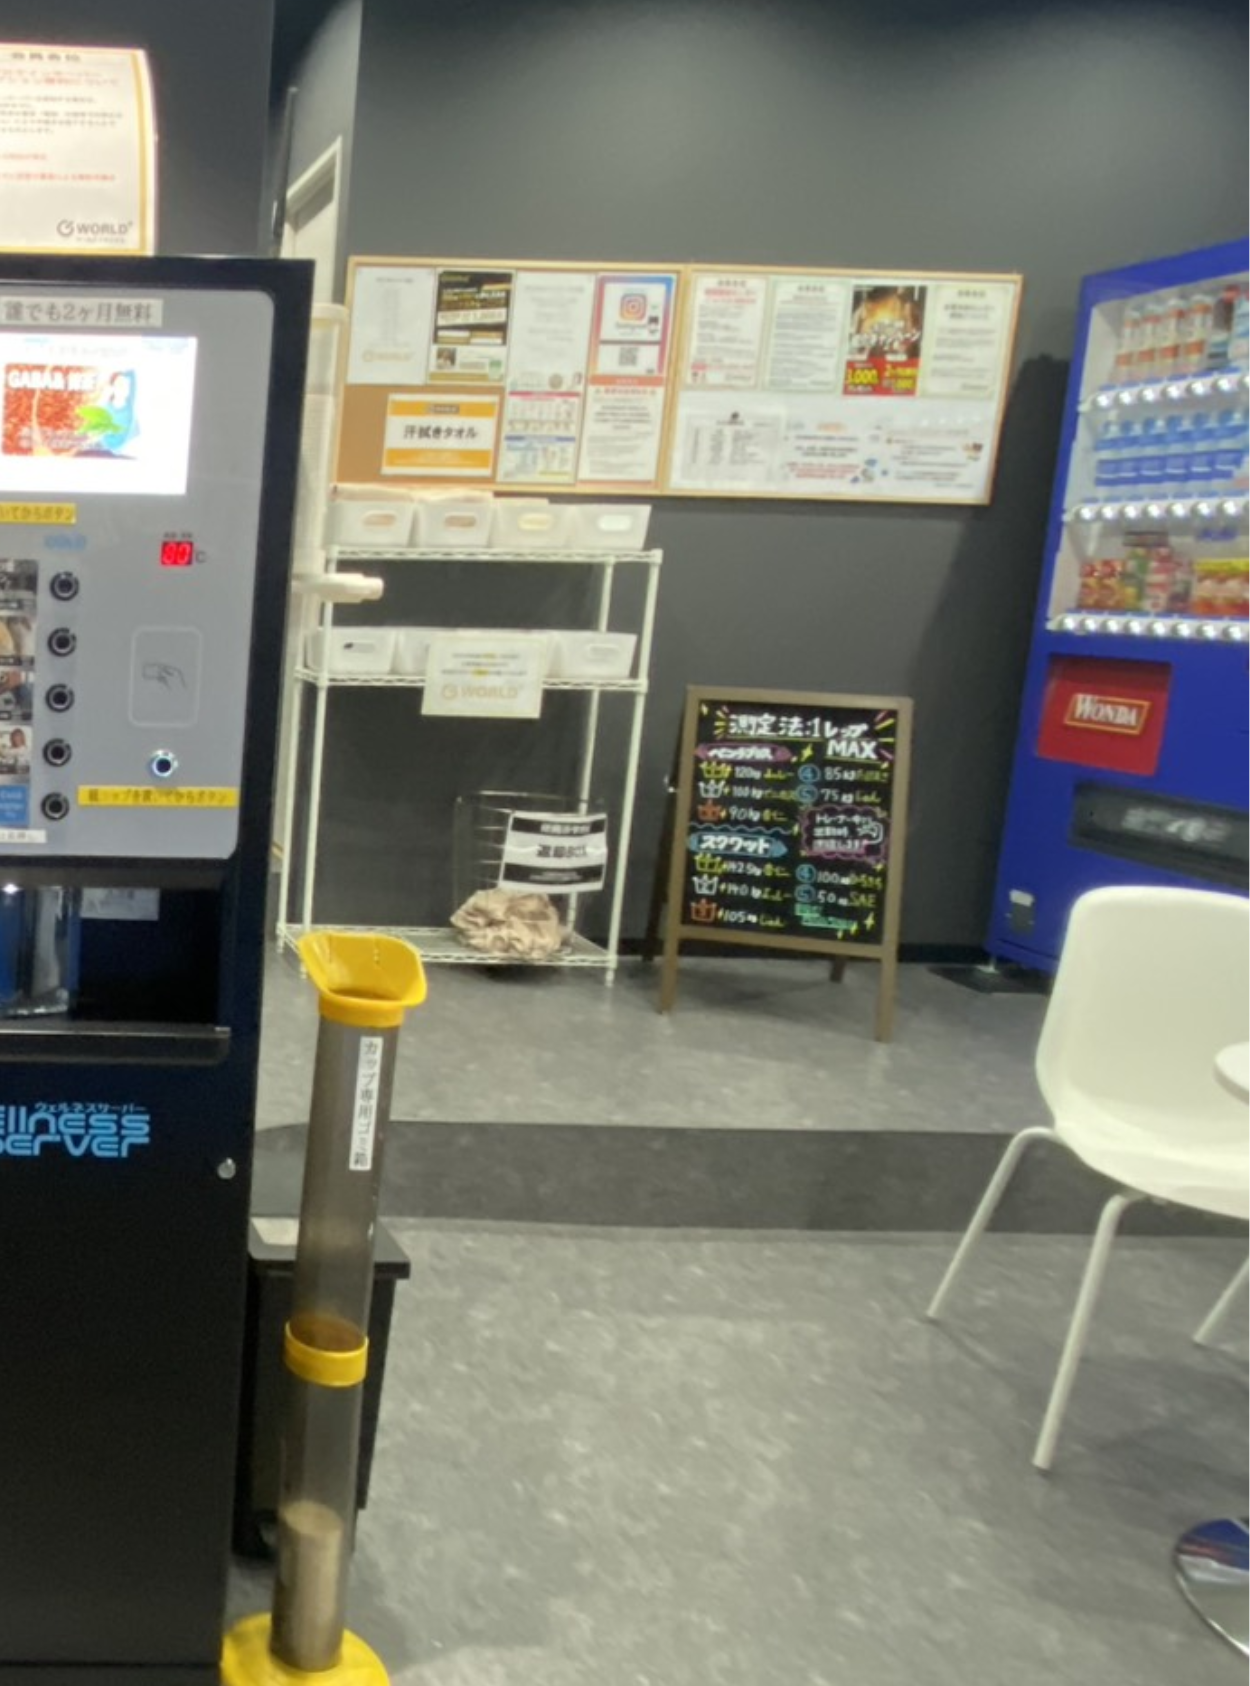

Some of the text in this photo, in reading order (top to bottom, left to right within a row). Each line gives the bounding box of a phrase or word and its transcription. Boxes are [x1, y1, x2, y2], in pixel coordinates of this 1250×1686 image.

[403, 425, 478, 440] 汗拭きタオル
[1074, 695, 1138, 726] WONDA
[827, 739, 877, 759] MAX
[700, 835, 770, 854] スクワット
[35, 1102, 146, 1114] ウェルネスサーバー
[353, 1040, 378, 1168] カップ専用ゴミ箱
